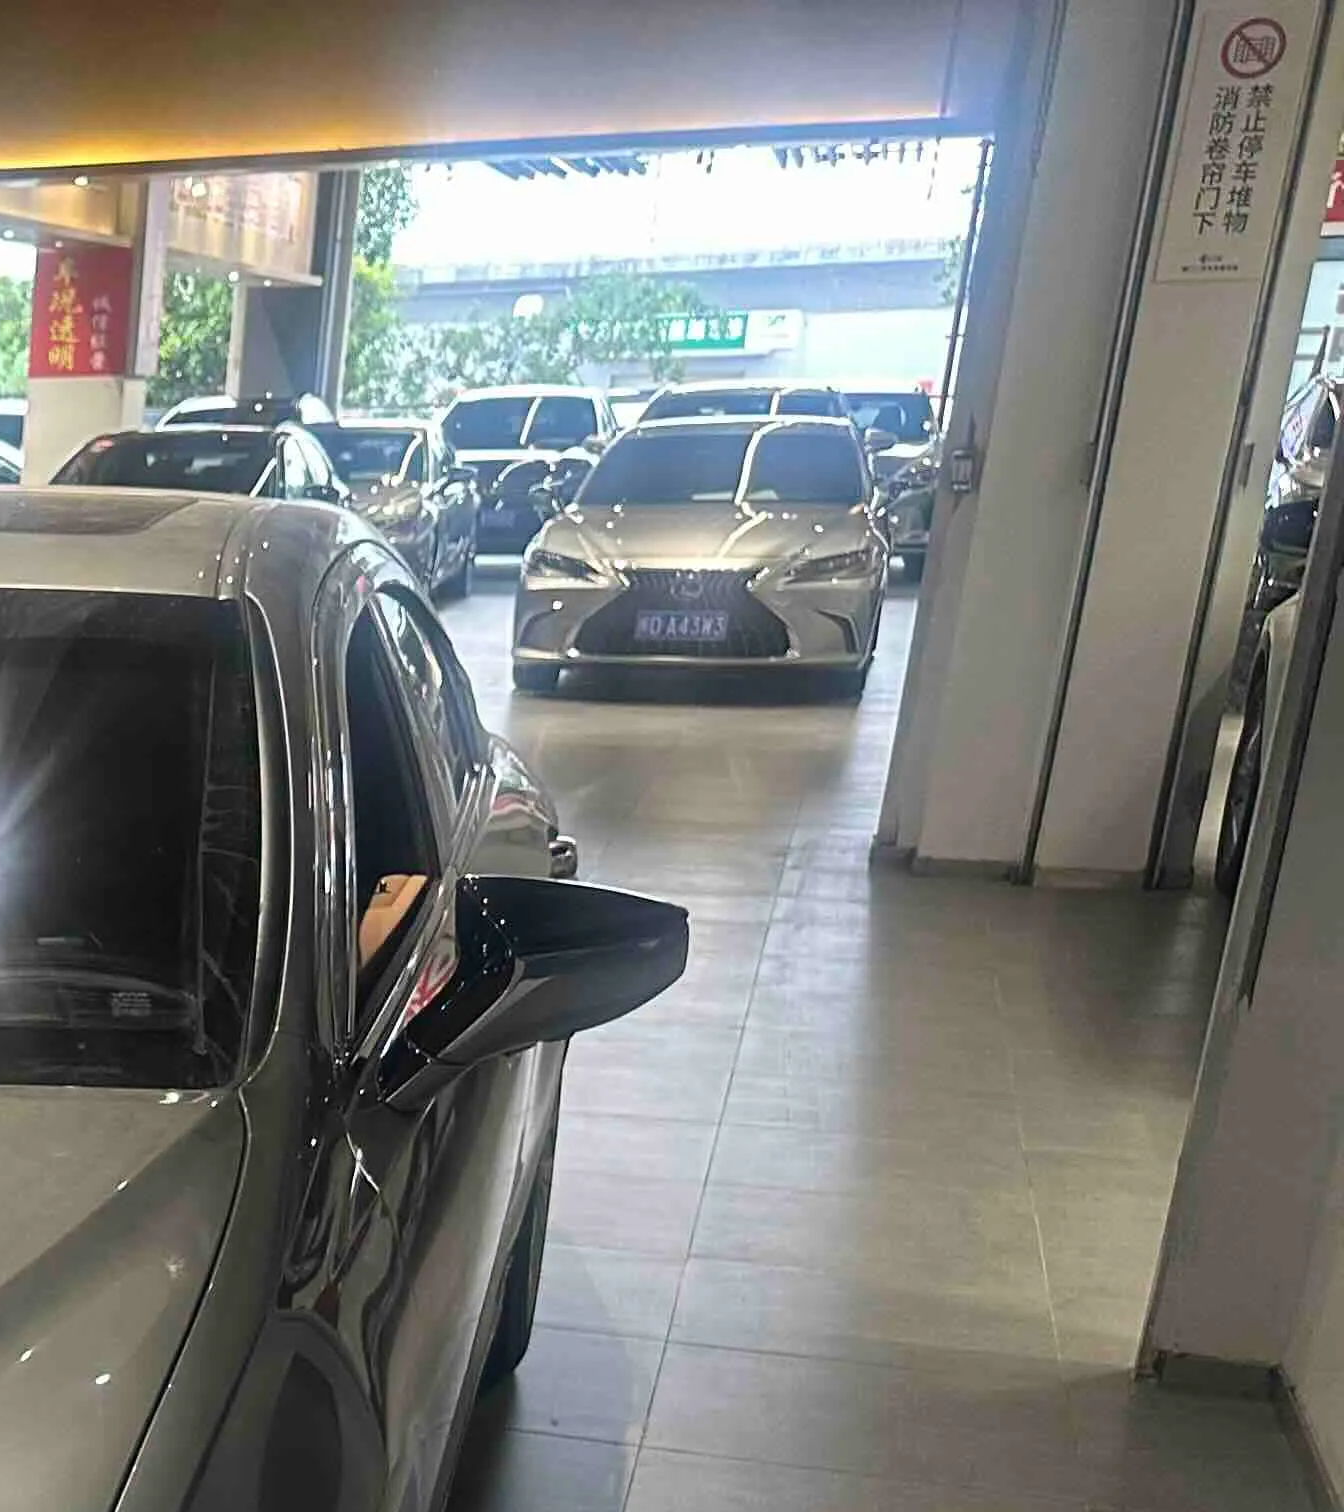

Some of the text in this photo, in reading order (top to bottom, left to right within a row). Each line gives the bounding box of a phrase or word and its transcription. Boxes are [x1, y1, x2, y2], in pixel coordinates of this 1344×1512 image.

[1193, 85, 1241, 235] 消防卷帘门下
[1223, 84, 1274, 234] 禁止停车堆物
